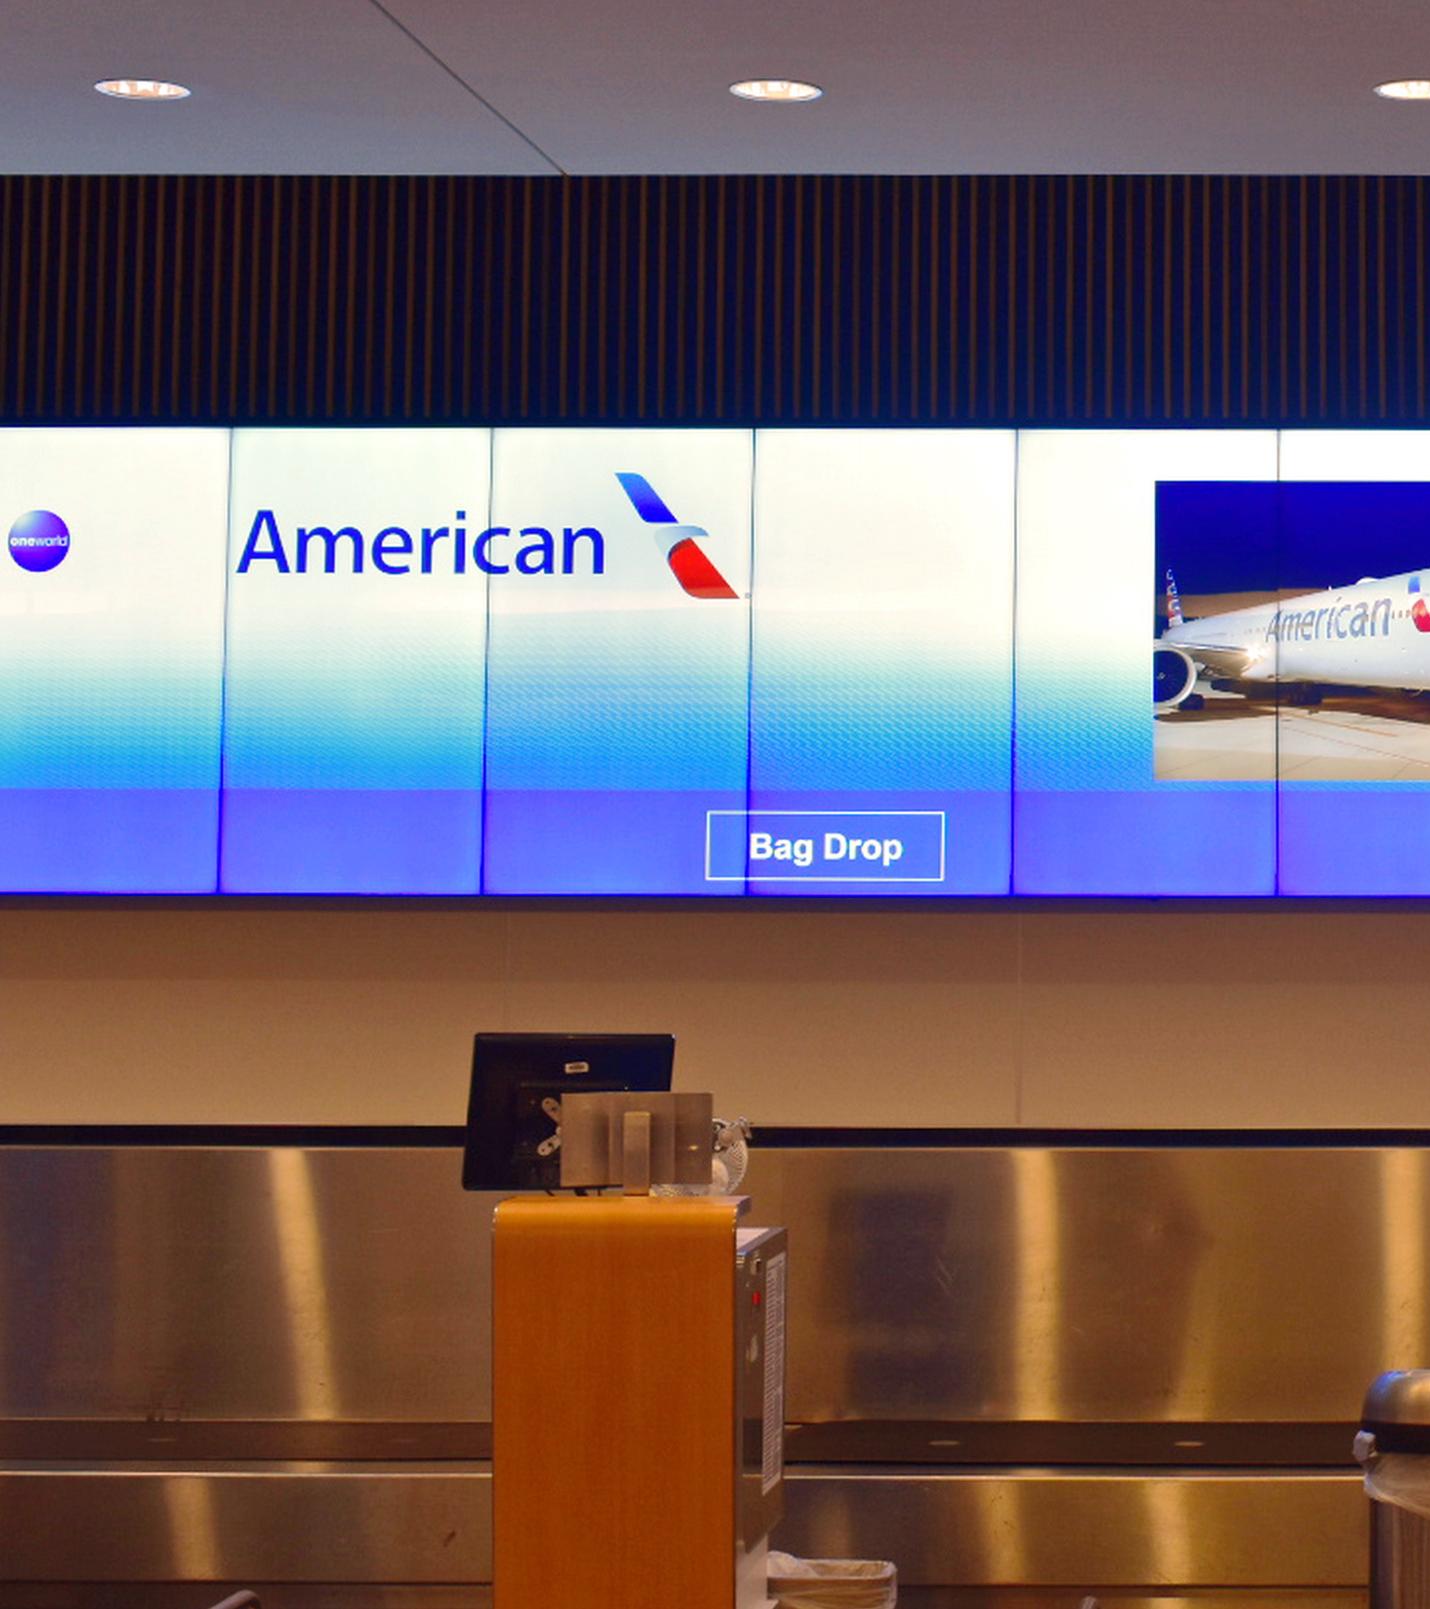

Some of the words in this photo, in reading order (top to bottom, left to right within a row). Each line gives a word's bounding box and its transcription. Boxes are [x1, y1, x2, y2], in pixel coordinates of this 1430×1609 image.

[11, 535, 68, 546] oneworld
[235, 510, 604, 574] American
[1265, 597, 1392, 642] American
[750, 832, 813, 867] Bag
[824, 832, 903, 867] Drop
